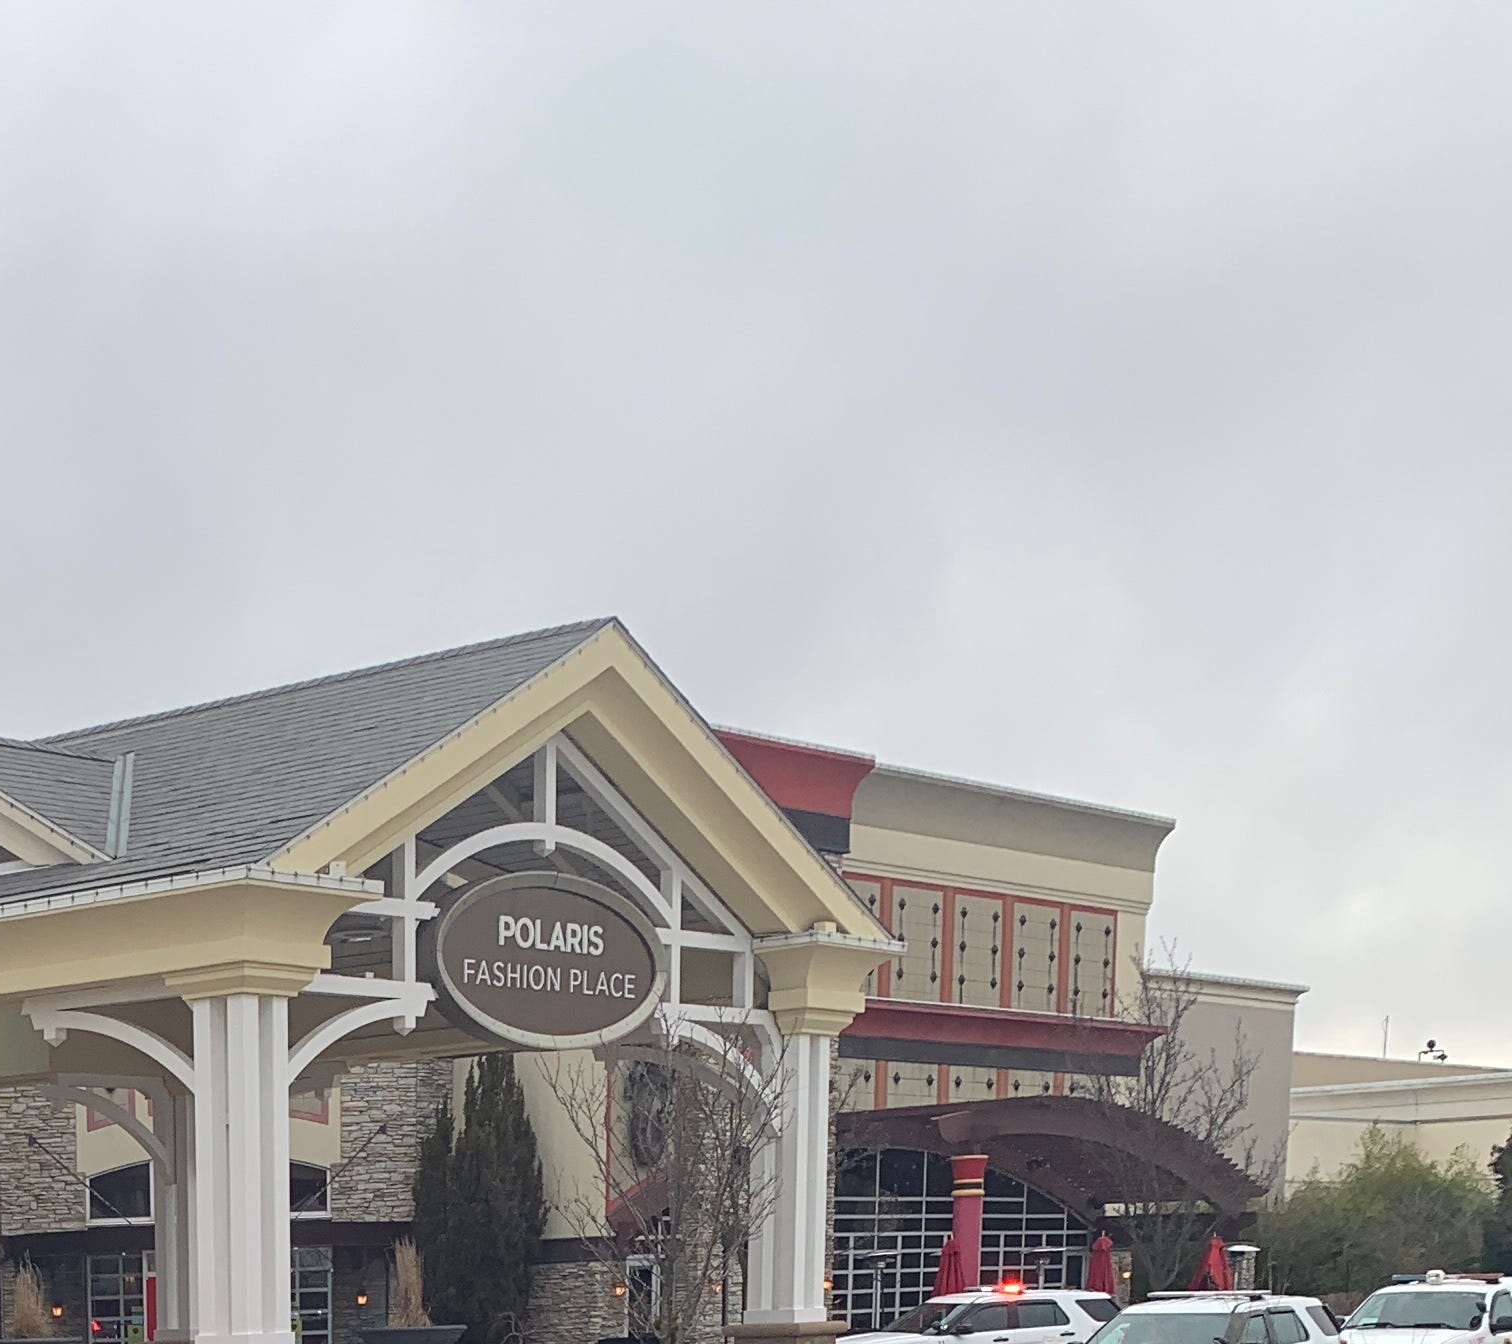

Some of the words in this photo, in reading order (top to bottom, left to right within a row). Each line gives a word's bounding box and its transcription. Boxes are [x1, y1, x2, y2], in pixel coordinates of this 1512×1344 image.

[498, 914, 604, 956] POLARIS
[463, 958, 561, 992] FASHION
[568, 968, 636, 999] PLACE
